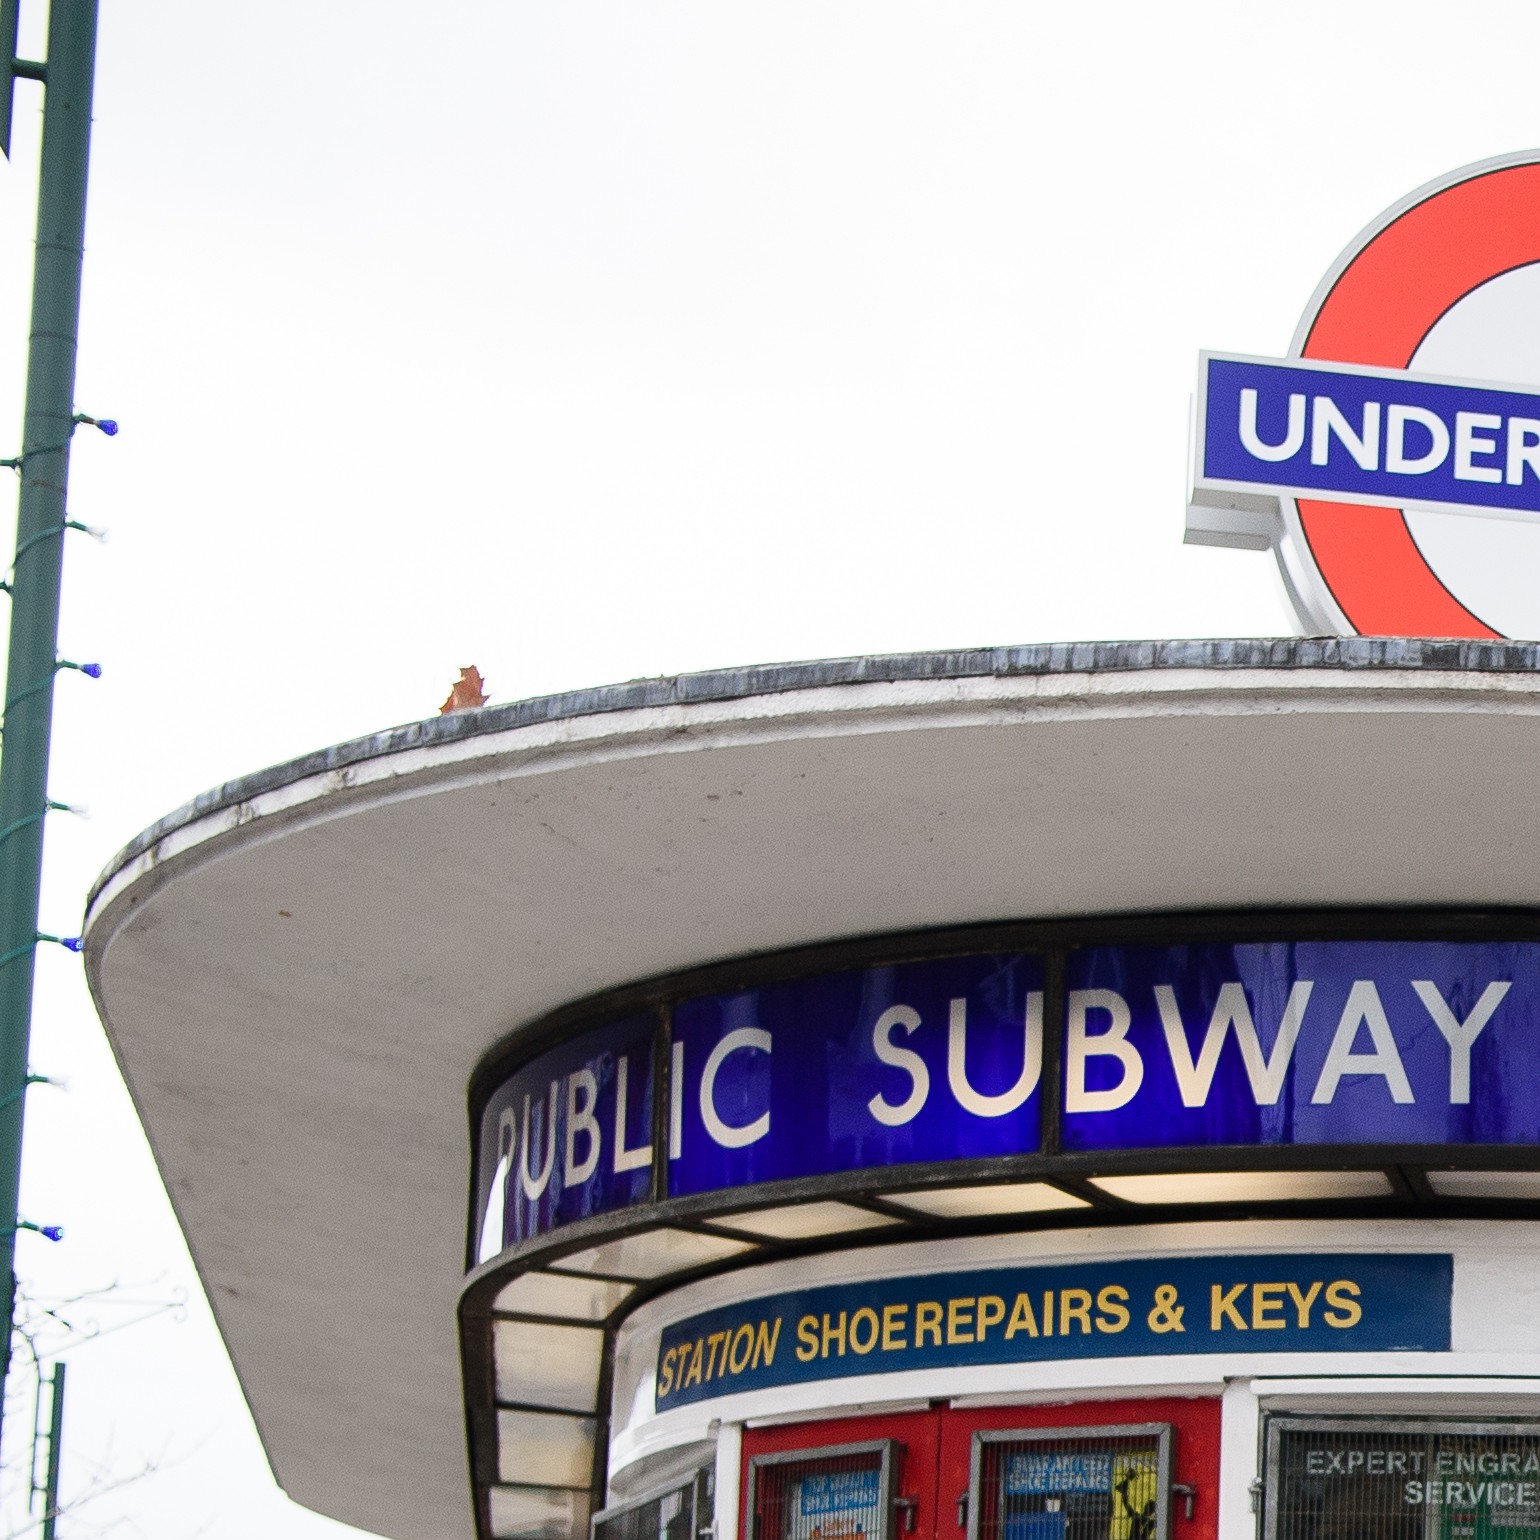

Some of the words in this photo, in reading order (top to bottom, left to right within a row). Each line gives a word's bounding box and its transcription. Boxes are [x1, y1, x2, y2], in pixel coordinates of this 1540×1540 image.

[497, 1027, 772, 1200] PUBLIC
[868, 979, 1512, 1126] SUBWAY
[657, 1317, 782, 1398] STATION
[1147, 1284, 1186, 1334] &
[1210, 1279, 1363, 1332] KEYS
[1306, 1450, 1426, 1476] EXPERT
[1403, 1480, 1538, 1507] SERVICE
